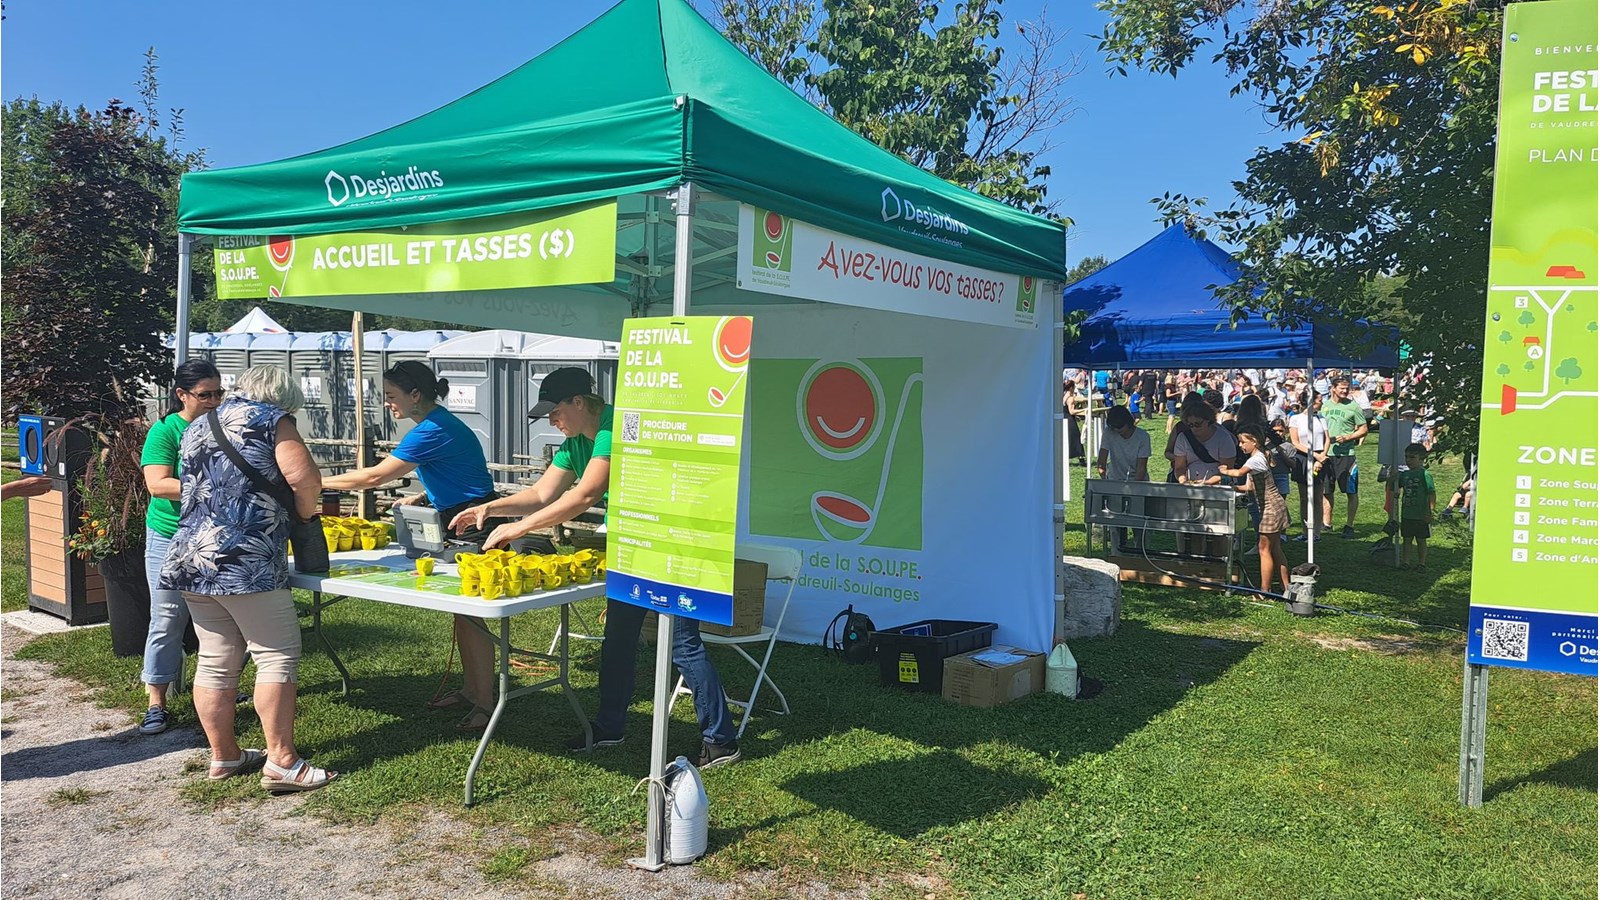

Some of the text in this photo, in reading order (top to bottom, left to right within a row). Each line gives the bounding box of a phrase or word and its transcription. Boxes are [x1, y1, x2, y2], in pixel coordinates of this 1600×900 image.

[1535, 44, 1598, 55] BIENVE
[1534, 70, 1598, 90] FEST
[1533, 93, 1598, 112] DE L
[1529, 148, 1583, 163] PLAN
[350, 166, 444, 199] Desjardins
[904, 199, 969, 235] Desjardins
[218, 235, 260, 248] FESTIVAL
[312, 228, 574, 270] ACCUEIL ET TASSES ($)
[220, 252, 245, 264] DE LA
[221, 267, 259, 281] S.O.U.PE.
[818, 241, 922, 289] Avez-vous
[928, 266, 953, 294] vos
[1518, 298, 1525, 307] 3
[628, 328, 692, 345] FESTIVAL
[626, 351, 662, 366] DE LA
[1530, 348, 1539, 357] A
[624, 371, 683, 389] S.O.U.PE.
[643, 419, 687, 431] PROCÉDURE
[642, 431, 652, 440] DE
[653, 432, 693, 443] VOTATION
[1517, 445, 1597, 466] ZONE
[1540, 478, 1570, 488] Zone
[1573, 480, 1598, 490] Sou
[1538, 497, 1569, 506] Zone
[1537, 515, 1568, 525] Zone
[1518, 533, 1524, 541] 4
[1536, 534, 1567, 543] Zone
[1536, 552, 1566, 562] Zone
[809, 551, 831, 568] de
[836, 553, 850, 571] la
[858, 556, 923, 581] S.O.U.PE.
